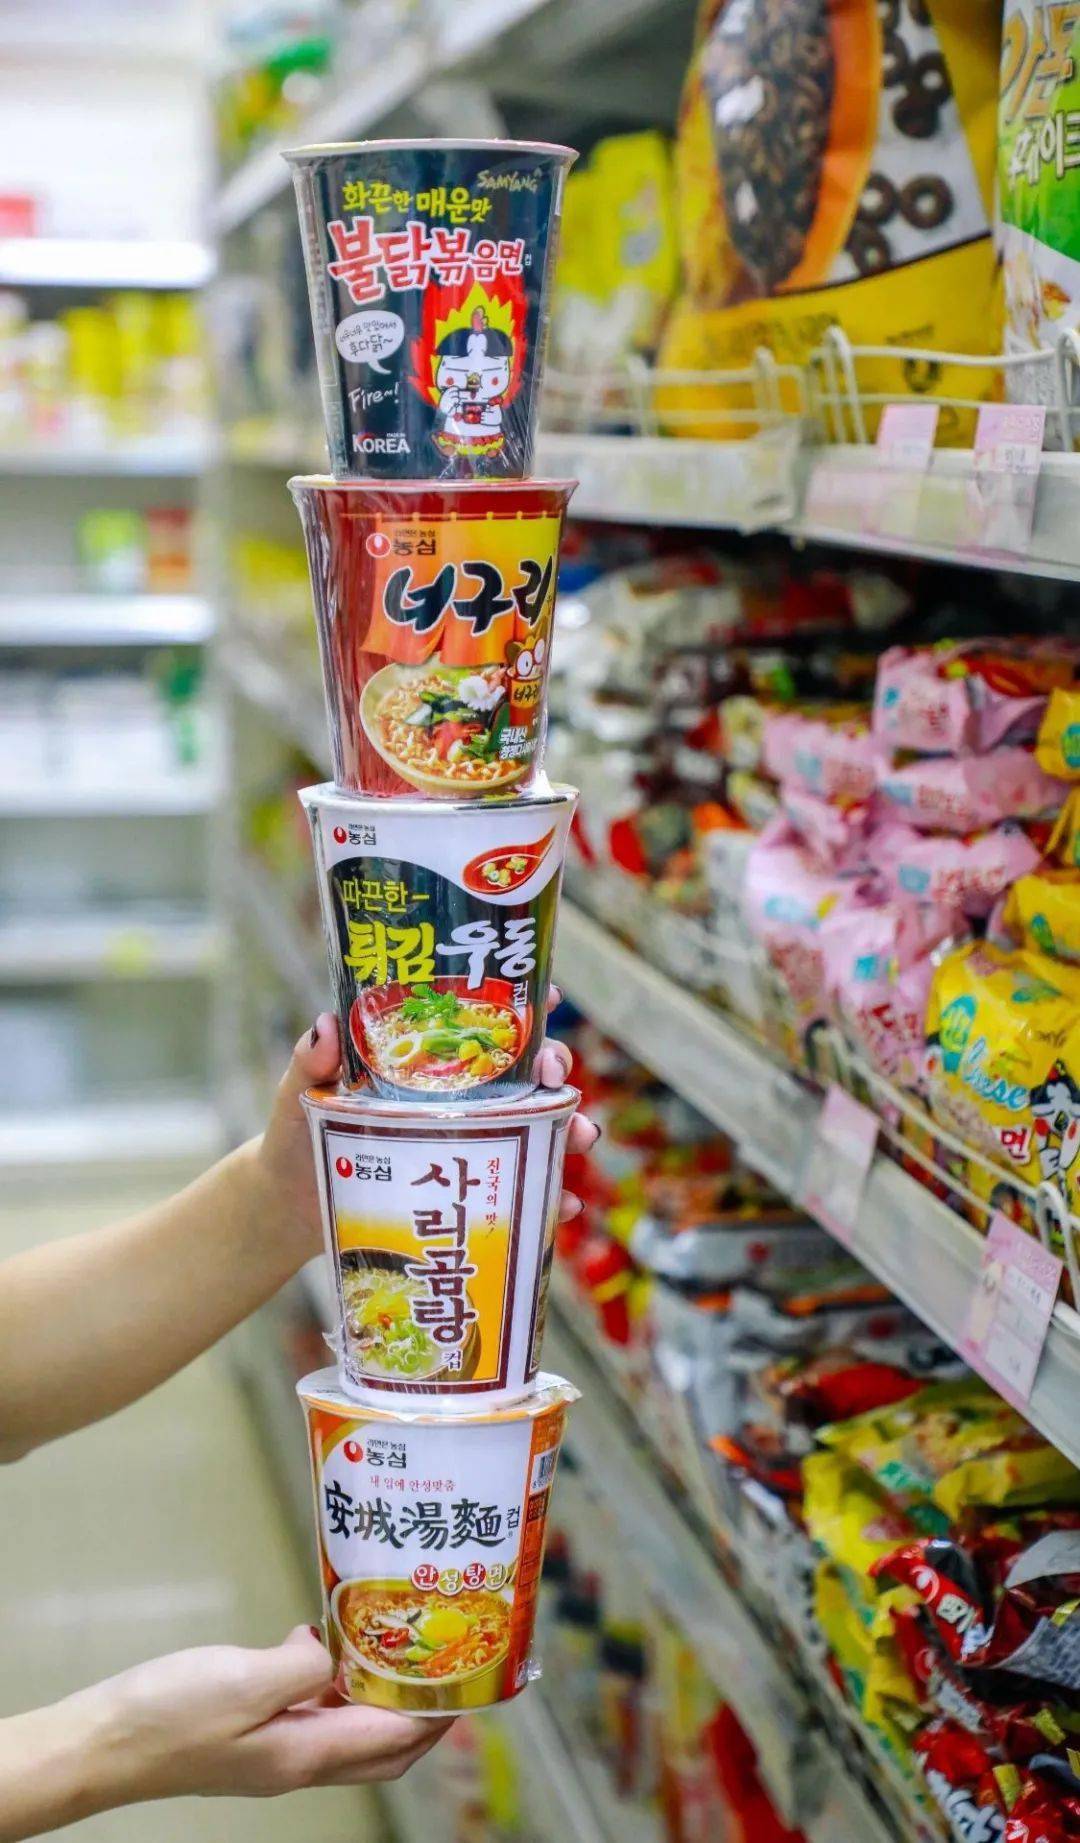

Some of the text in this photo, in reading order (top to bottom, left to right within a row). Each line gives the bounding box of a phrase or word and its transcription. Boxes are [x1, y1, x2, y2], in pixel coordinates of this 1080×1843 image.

[342, 180, 492, 224] 화끈한 매운맛
[328, 216, 525, 305] 불닭볶음면
[352, 433, 411, 454] KOREA
[393, 539, 437, 556] 농심
[383, 555, 553, 638] 너구리
[349, 830, 377, 846] 농심
[355, 1162, 392, 1181] 농심
[407, 1156, 482, 1344] 사리곰탕
[366, 1447, 407, 1469] 농심
[324, 1480, 506, 1551] 安城湯麵
[507, 1505, 521, 1529] 컵
[413, 1563, 506, 1593] 안성탕면
